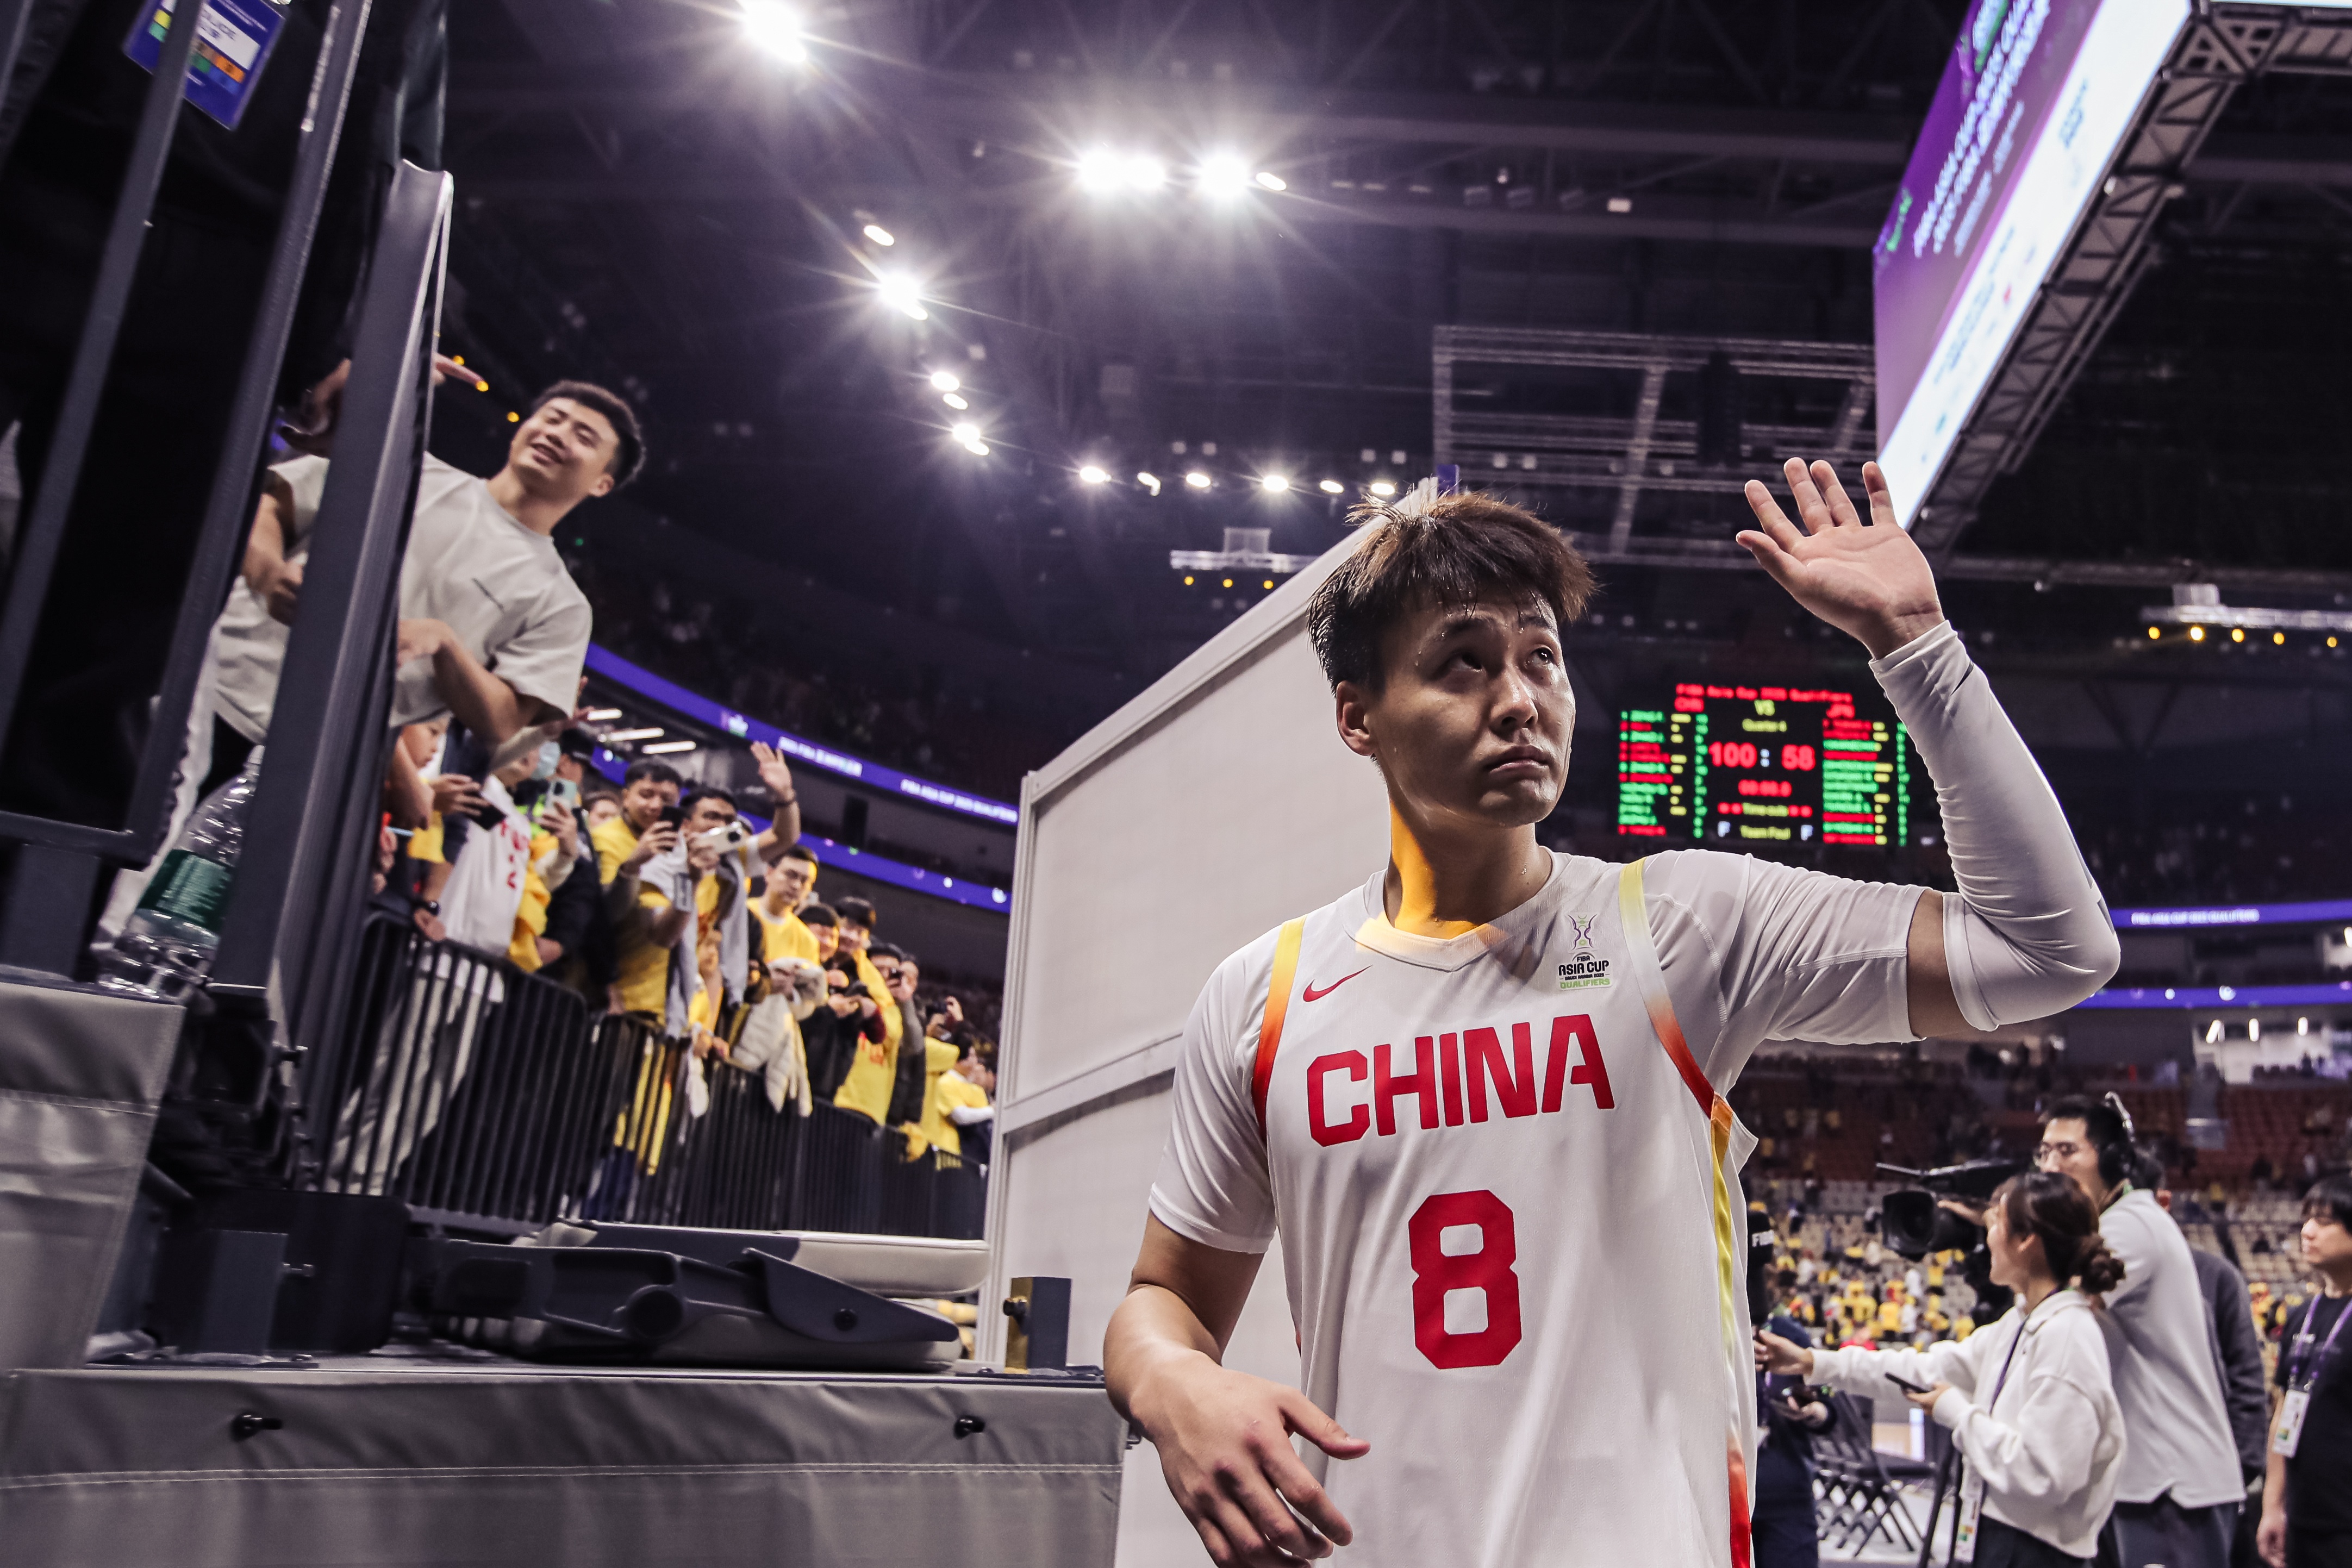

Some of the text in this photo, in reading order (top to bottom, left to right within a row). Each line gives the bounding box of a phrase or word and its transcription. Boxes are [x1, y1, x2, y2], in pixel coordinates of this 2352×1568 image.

[1708, 741, 1757, 769] 100
[1558, 960, 1609, 976] ASIA CUP
[1559, 978, 1610, 989] QUALIFIERS
[1307, 1014, 1615, 1147] CHINA
[1408, 1189, 1522, 1370] 8
